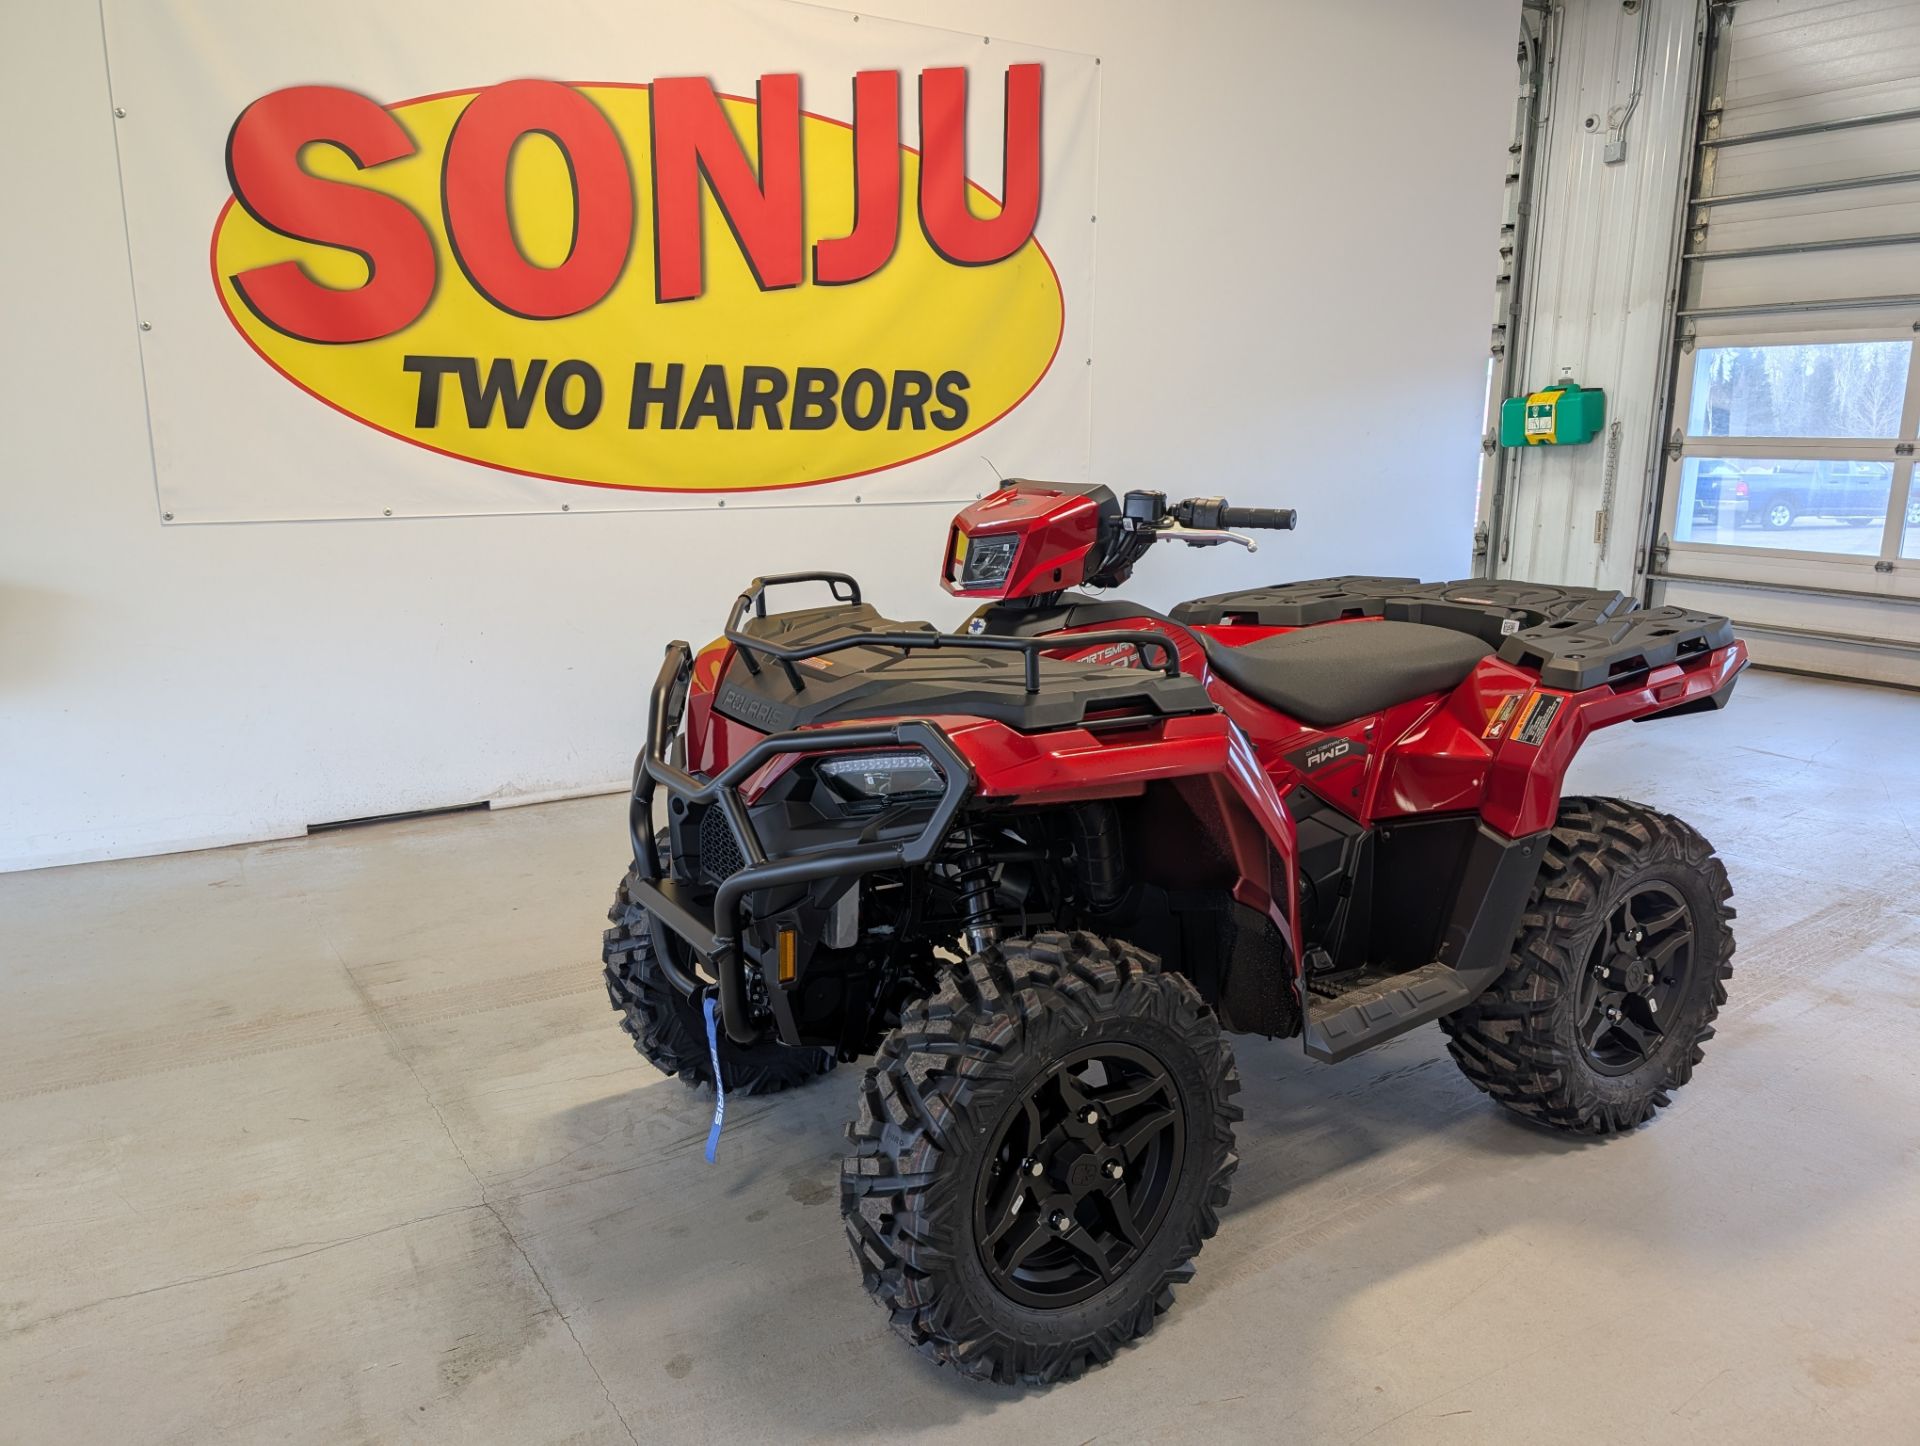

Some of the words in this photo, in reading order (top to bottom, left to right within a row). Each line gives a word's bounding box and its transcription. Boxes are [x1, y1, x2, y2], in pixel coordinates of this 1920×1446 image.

[225, 63, 1042, 345] SONJU
[402, 356, 604, 431] TWO
[628, 363, 971, 431] HARBORS
[722, 689, 784, 725] POLARIS
[1307, 742, 1349, 768] AWD
[710, 1047, 725, 1126] POLARIS
